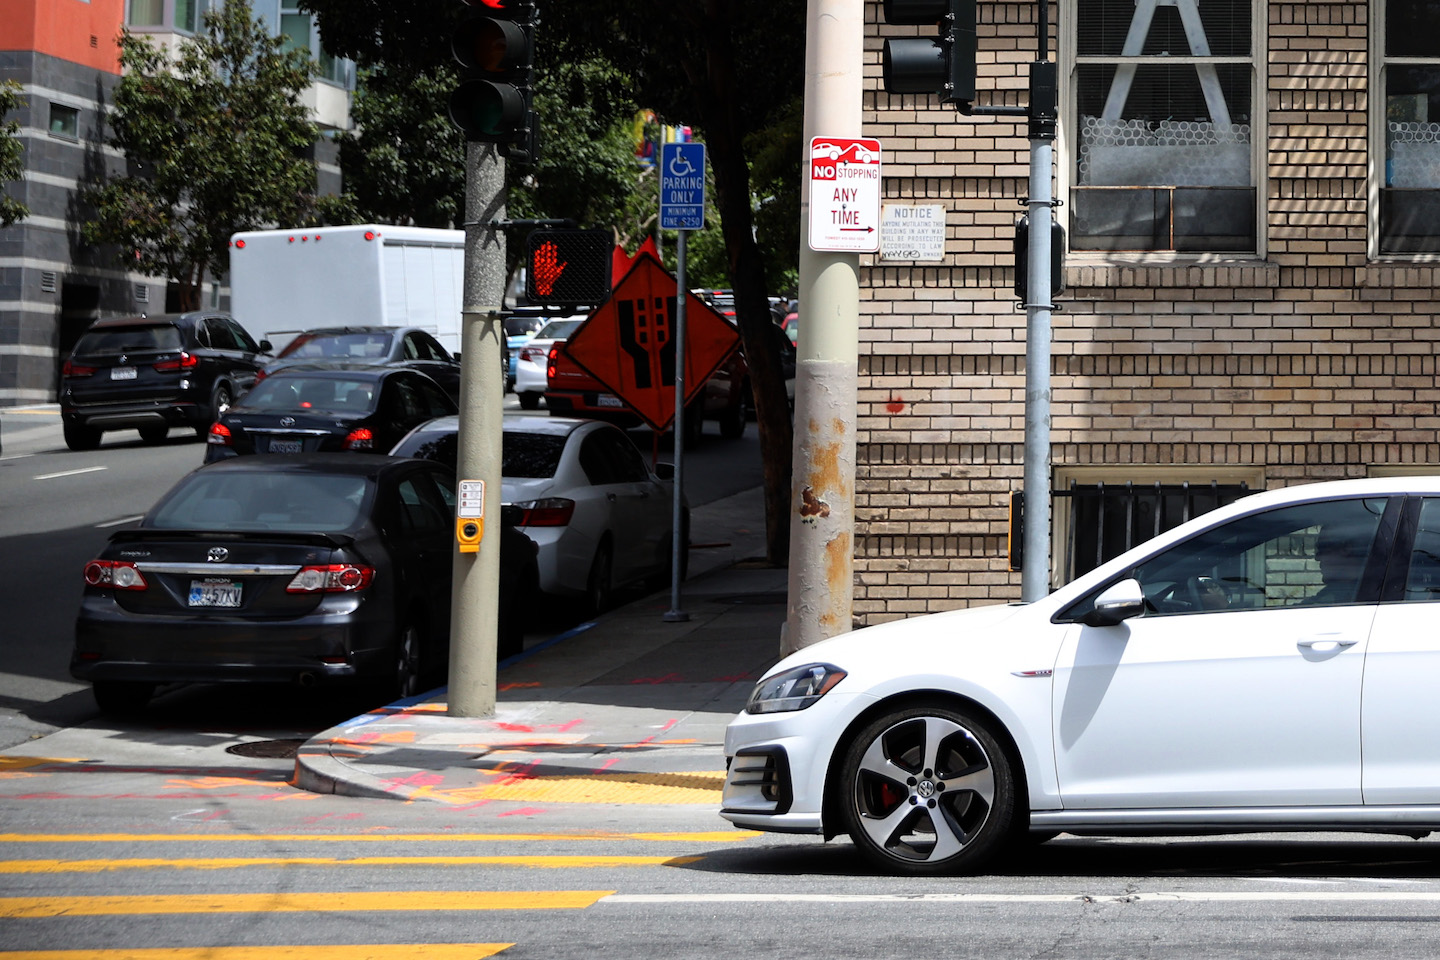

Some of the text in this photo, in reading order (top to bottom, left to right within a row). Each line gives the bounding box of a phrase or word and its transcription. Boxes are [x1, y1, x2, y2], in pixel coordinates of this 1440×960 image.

[814, 165, 878, 179] NO STOPPING
[663, 176, 703, 190] PARKING
[670, 190, 695, 204] ONLY
[833, 187, 858, 202] ANY
[667, 207, 697, 216] MINIMUM
[831, 210, 860, 225] TIME
[894, 208, 932, 218] NOTICE
[663, 217, 679, 226] FINE
